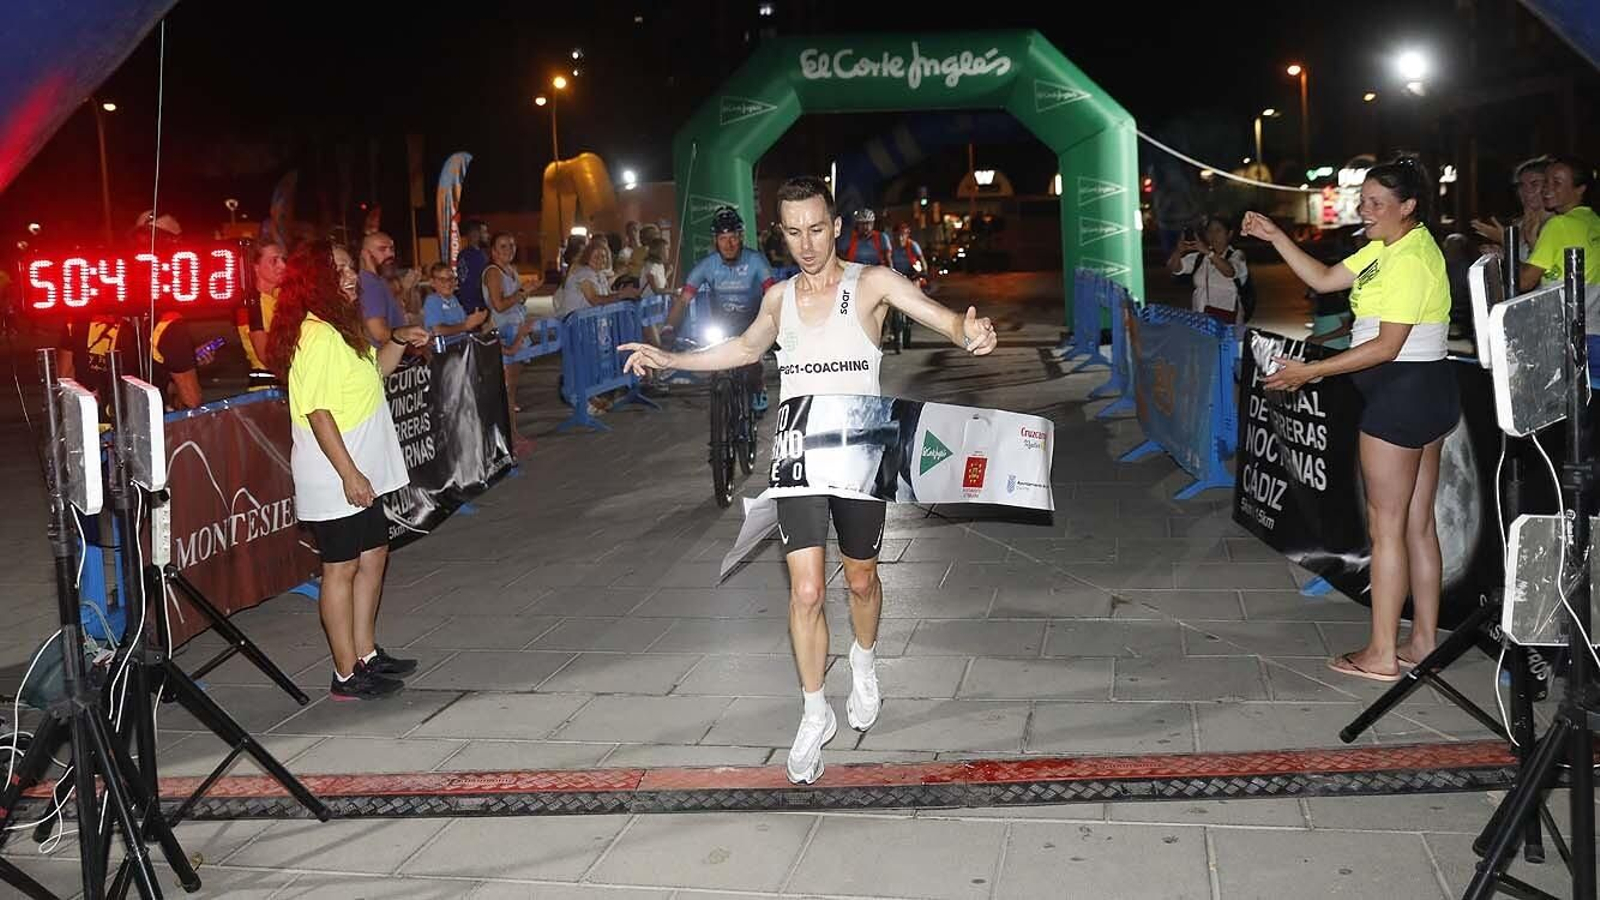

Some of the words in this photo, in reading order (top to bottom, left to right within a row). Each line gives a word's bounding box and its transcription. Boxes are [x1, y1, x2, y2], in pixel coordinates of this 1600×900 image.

[800, 48, 832, 79] El
[833, 48, 905, 79] Corte
[907, 41, 1011, 89] Inglés
[840, 289, 851, 315] soar
[1249, 394, 1269, 422] DE
[1243, 462, 1287, 511] CÁDIZ
